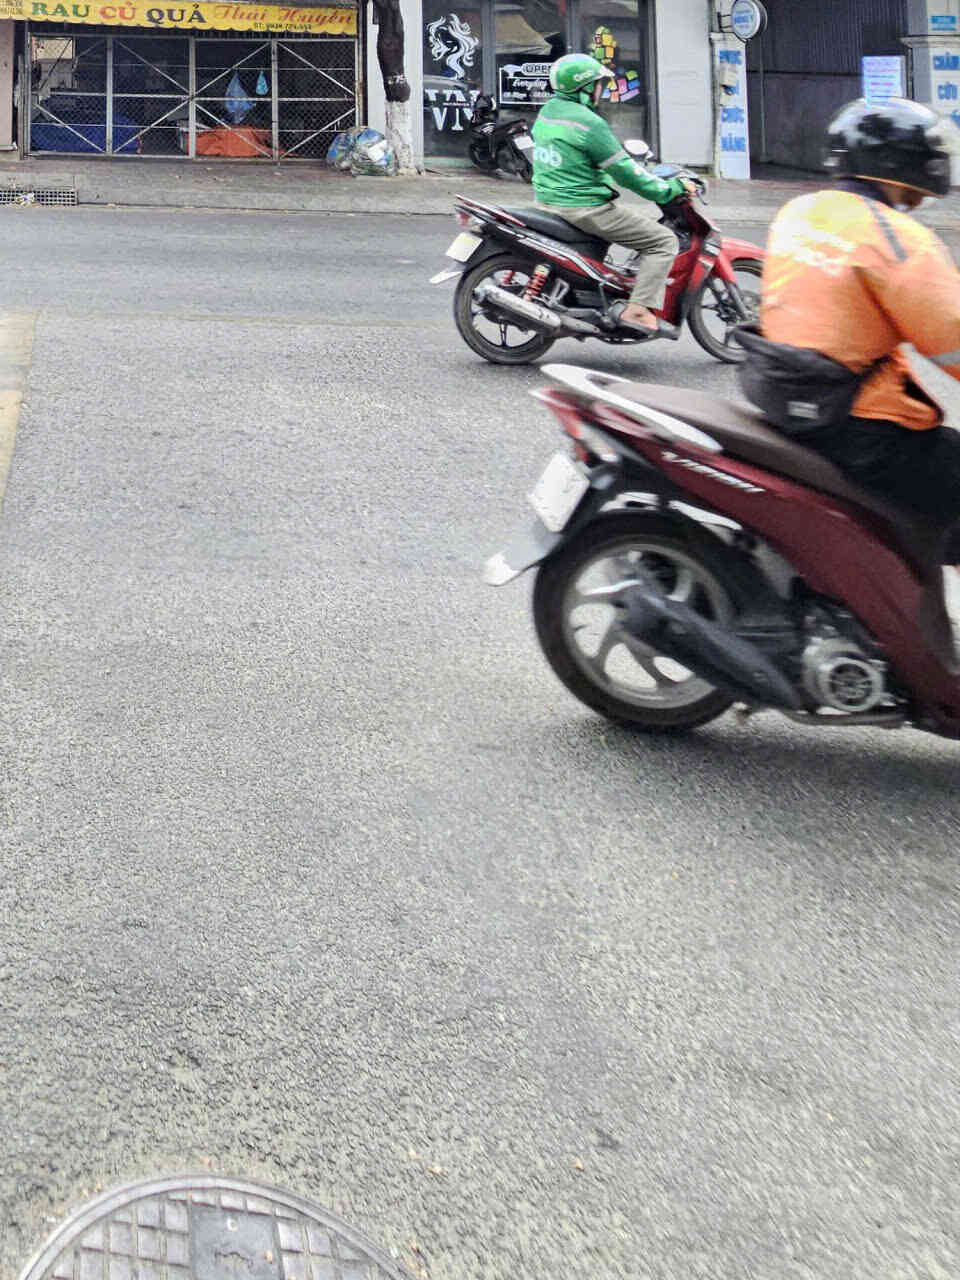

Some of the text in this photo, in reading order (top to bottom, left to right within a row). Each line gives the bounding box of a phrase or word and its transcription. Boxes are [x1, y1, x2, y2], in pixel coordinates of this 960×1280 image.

[31, 1, 90, 19] RAU
[99, 0, 137, 21] CỦ
[146, 3, 207, 24] QUẢ
